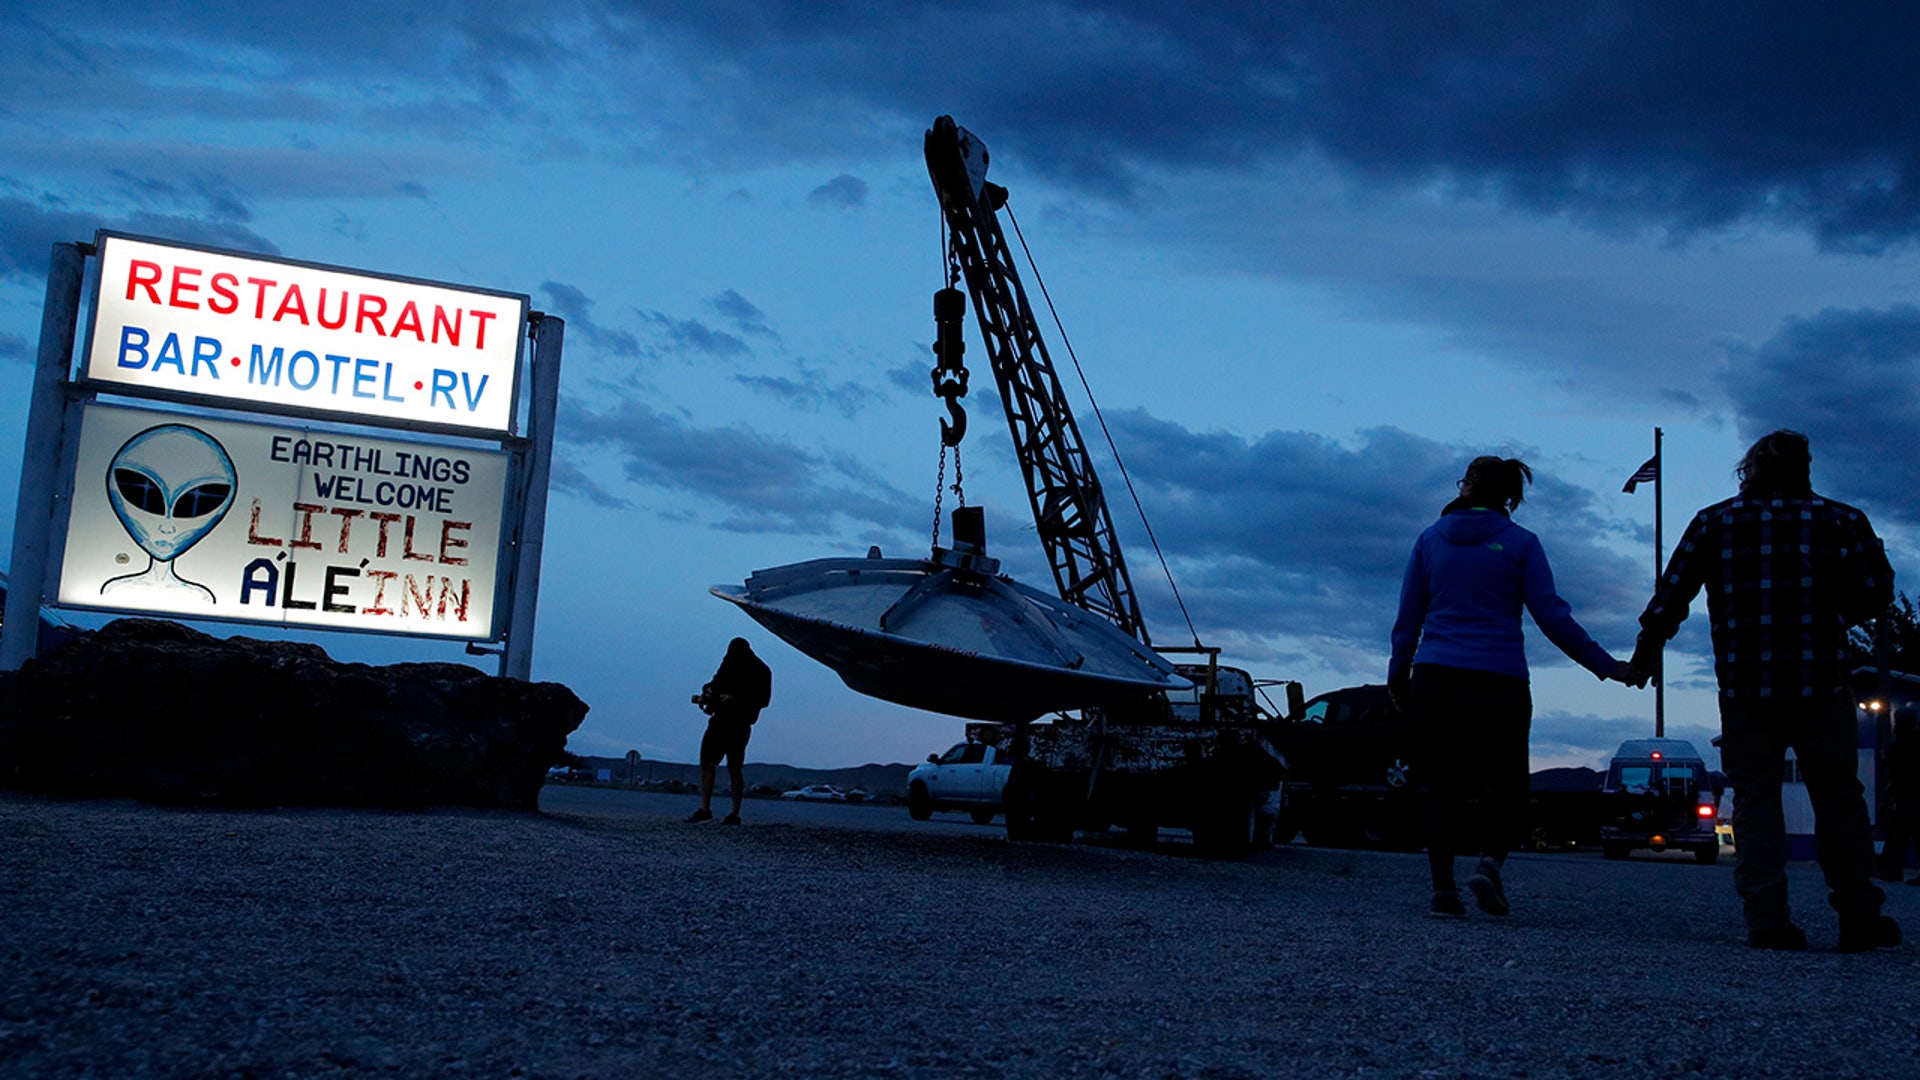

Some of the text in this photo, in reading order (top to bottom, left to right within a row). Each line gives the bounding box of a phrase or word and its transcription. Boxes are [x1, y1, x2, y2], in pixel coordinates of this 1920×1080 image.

[125, 259, 497, 350] RESTAURANT
[118, 326, 490, 412] BAR MOTEL RV
[270, 436, 471, 484] EARTHLINGS
[313, 473, 454, 513] WELCOME
[247, 498, 473, 566] LITTLE
